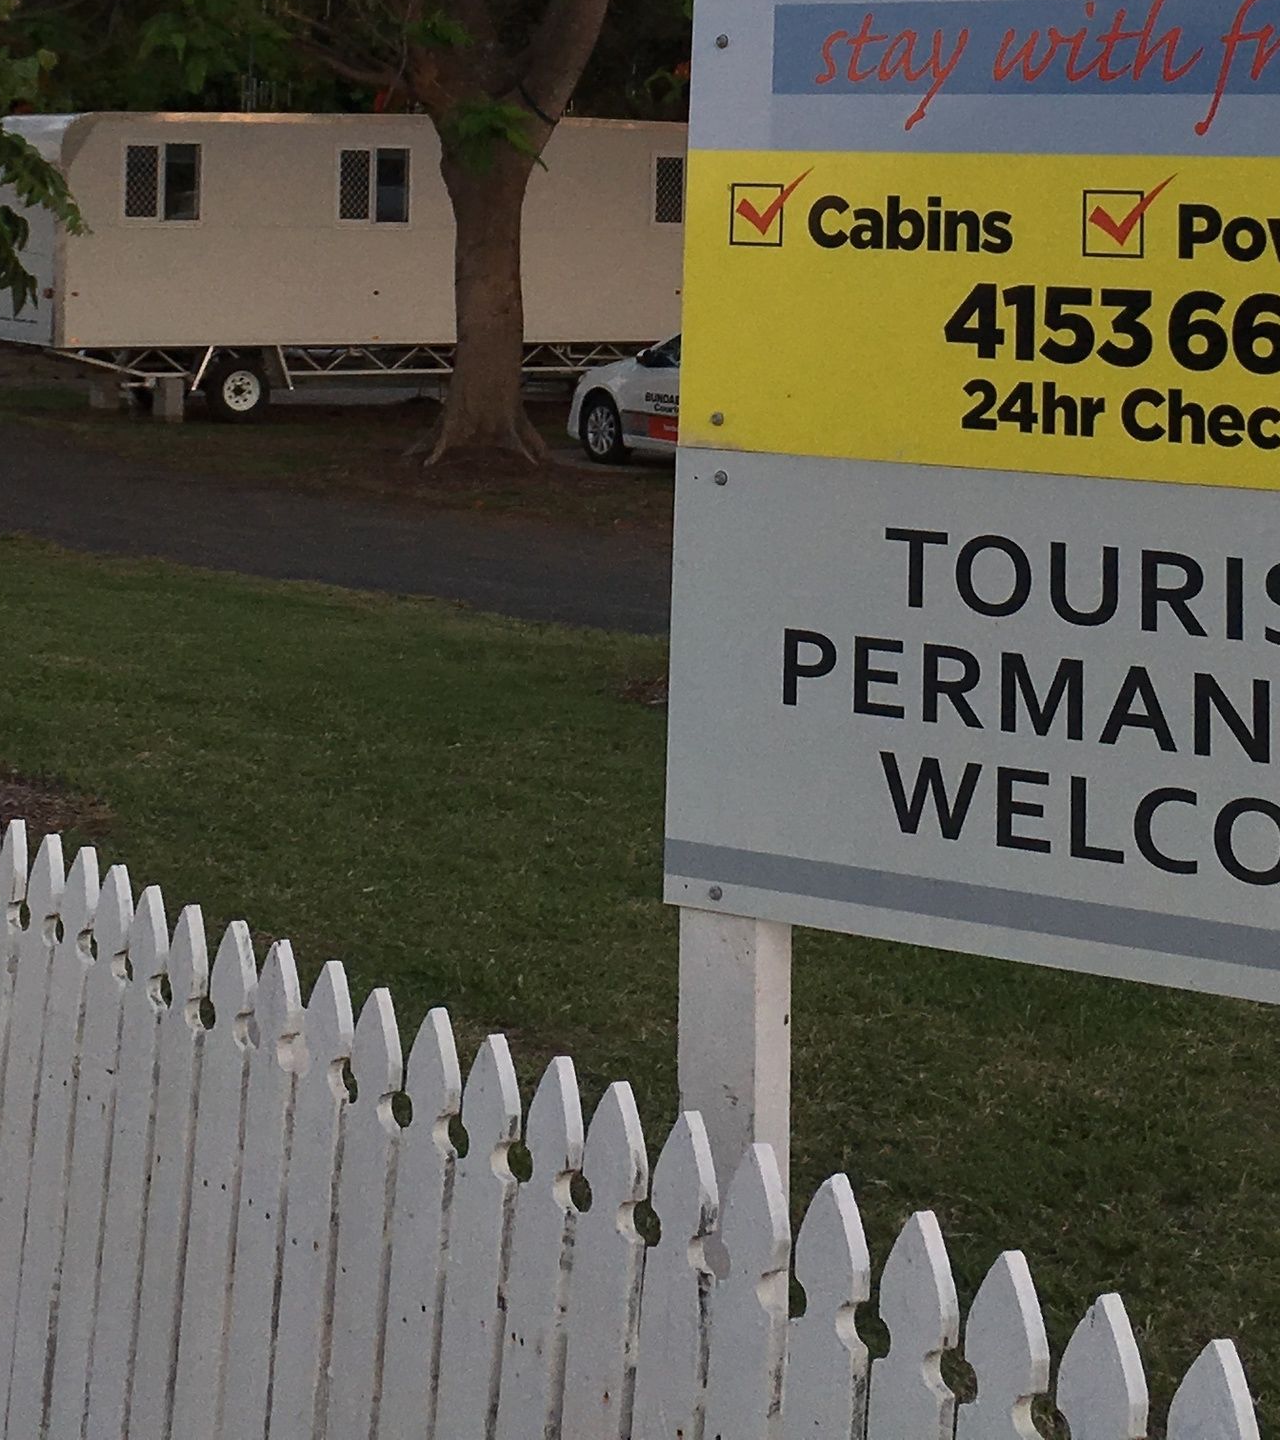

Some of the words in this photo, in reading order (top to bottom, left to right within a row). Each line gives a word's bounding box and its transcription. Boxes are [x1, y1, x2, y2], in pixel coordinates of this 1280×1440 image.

[815, 13, 970, 132] stay
[807, 194, 1014, 255] Cabins
[960, 377, 1107, 439] 24hr
